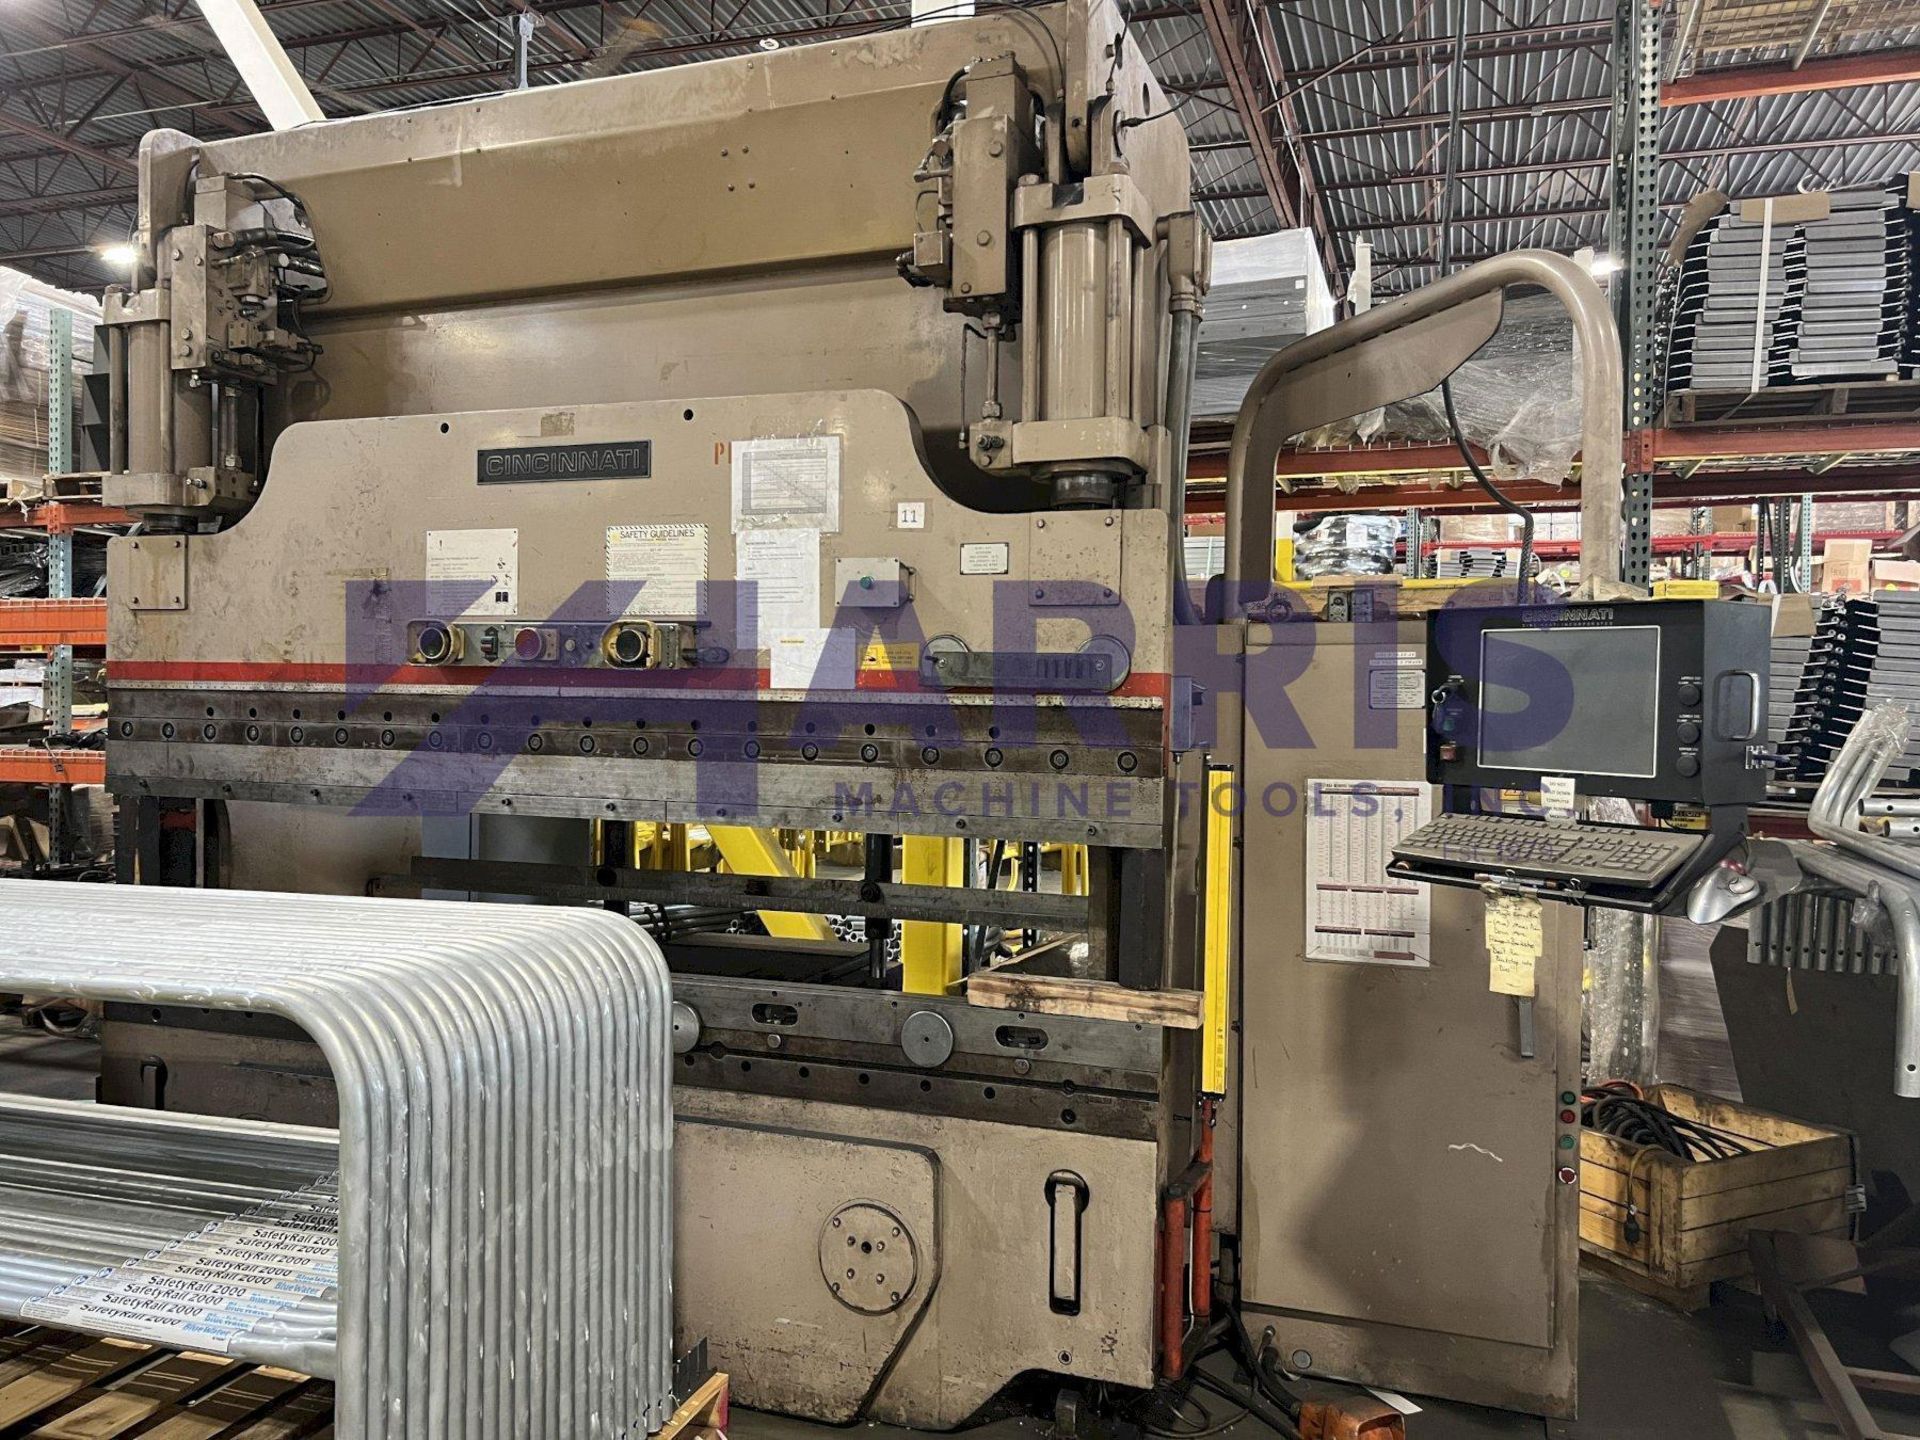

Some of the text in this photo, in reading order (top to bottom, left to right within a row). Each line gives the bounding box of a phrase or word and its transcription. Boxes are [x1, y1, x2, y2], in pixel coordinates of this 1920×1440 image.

[486, 448, 640, 476] CINCINNATI
[901, 509, 918, 523] 11
[620, 528, 695, 539] SAFETY GUIDELINES
[1521, 608, 1614, 623] CINCINNATI
[235, 1237, 330, 1255] SafetyRail 2000
[252, 1228, 338, 1246] SafetyRail 200
[215, 1247, 311, 1266] SafetyRail 2000
[195, 1257, 259, 1272] SafetyRail
[259, 1266, 292, 1277] 2000
[148, 1275, 210, 1292] SafetyRail
[212, 1285, 246, 1297] 2000
[174, 1265, 320, 1294] SafetyRail 2000 BlueWater
[124, 1283, 189, 1300] SafetyRail
[189, 1293, 223, 1305] 2000
[102, 1293, 167, 1311] SafetyRail
[167, 1304, 203, 1316] 2000
[79, 1304, 230, 1336] SafetyRail 2000 BlueWater
